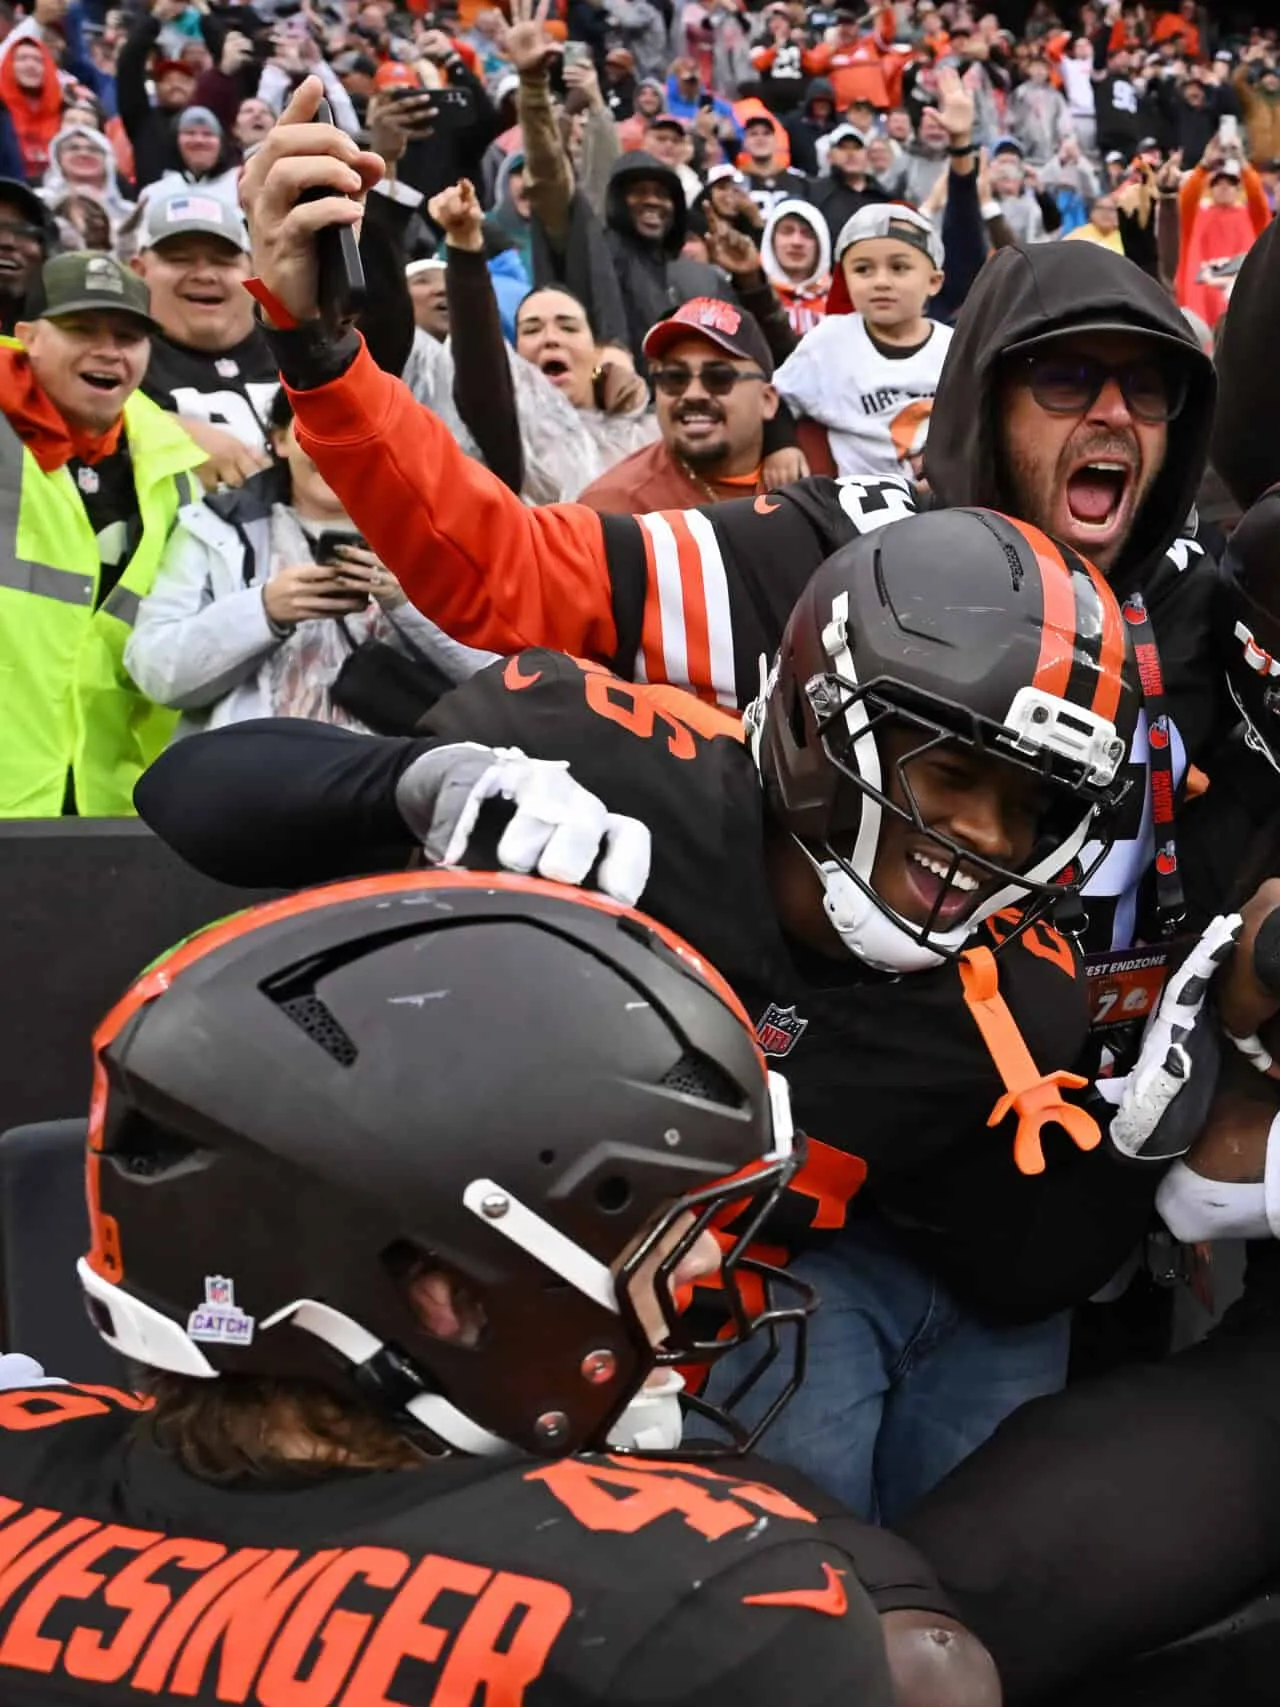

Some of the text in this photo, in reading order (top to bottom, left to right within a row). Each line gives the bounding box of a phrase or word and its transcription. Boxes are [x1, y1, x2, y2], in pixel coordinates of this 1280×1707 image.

[1084, 954, 1166, 977] EST ENDZONE
[193, 1314, 249, 1334] CATCH
